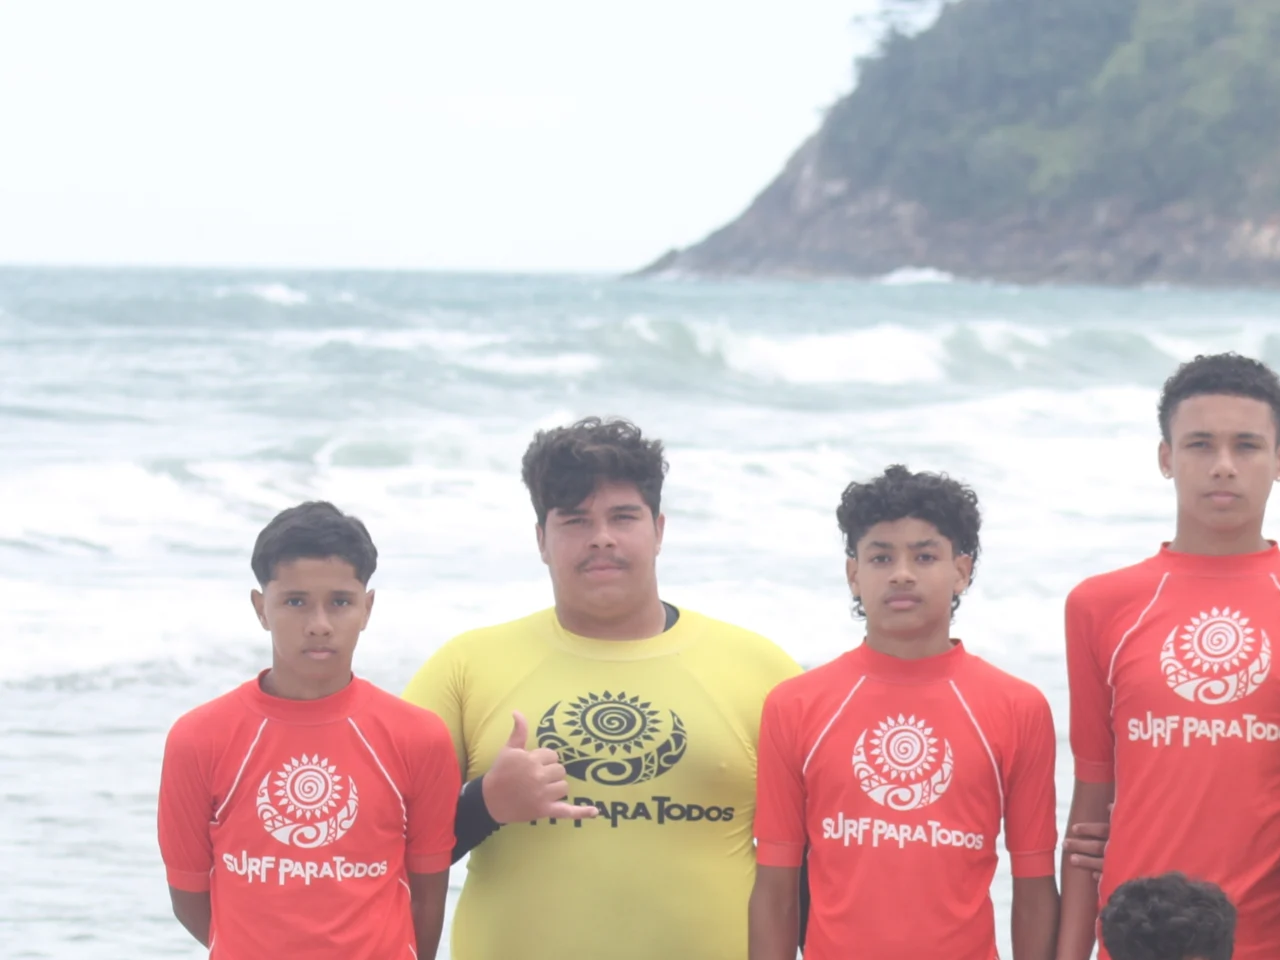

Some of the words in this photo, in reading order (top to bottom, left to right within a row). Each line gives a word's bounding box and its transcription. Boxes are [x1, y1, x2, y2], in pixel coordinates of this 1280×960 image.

[1128, 711, 1180, 748] SURF
[1183, 717, 1243, 747] PARA
[651, 796, 735, 825] TODOS
[822, 812, 872, 847] SURF
[872, 820, 927, 849] PARA
[928, 820, 984, 850] TODOS
[222, 850, 276, 883] SURF
[278, 859, 334, 885] PARA
[333, 857, 388, 882] TODOS
